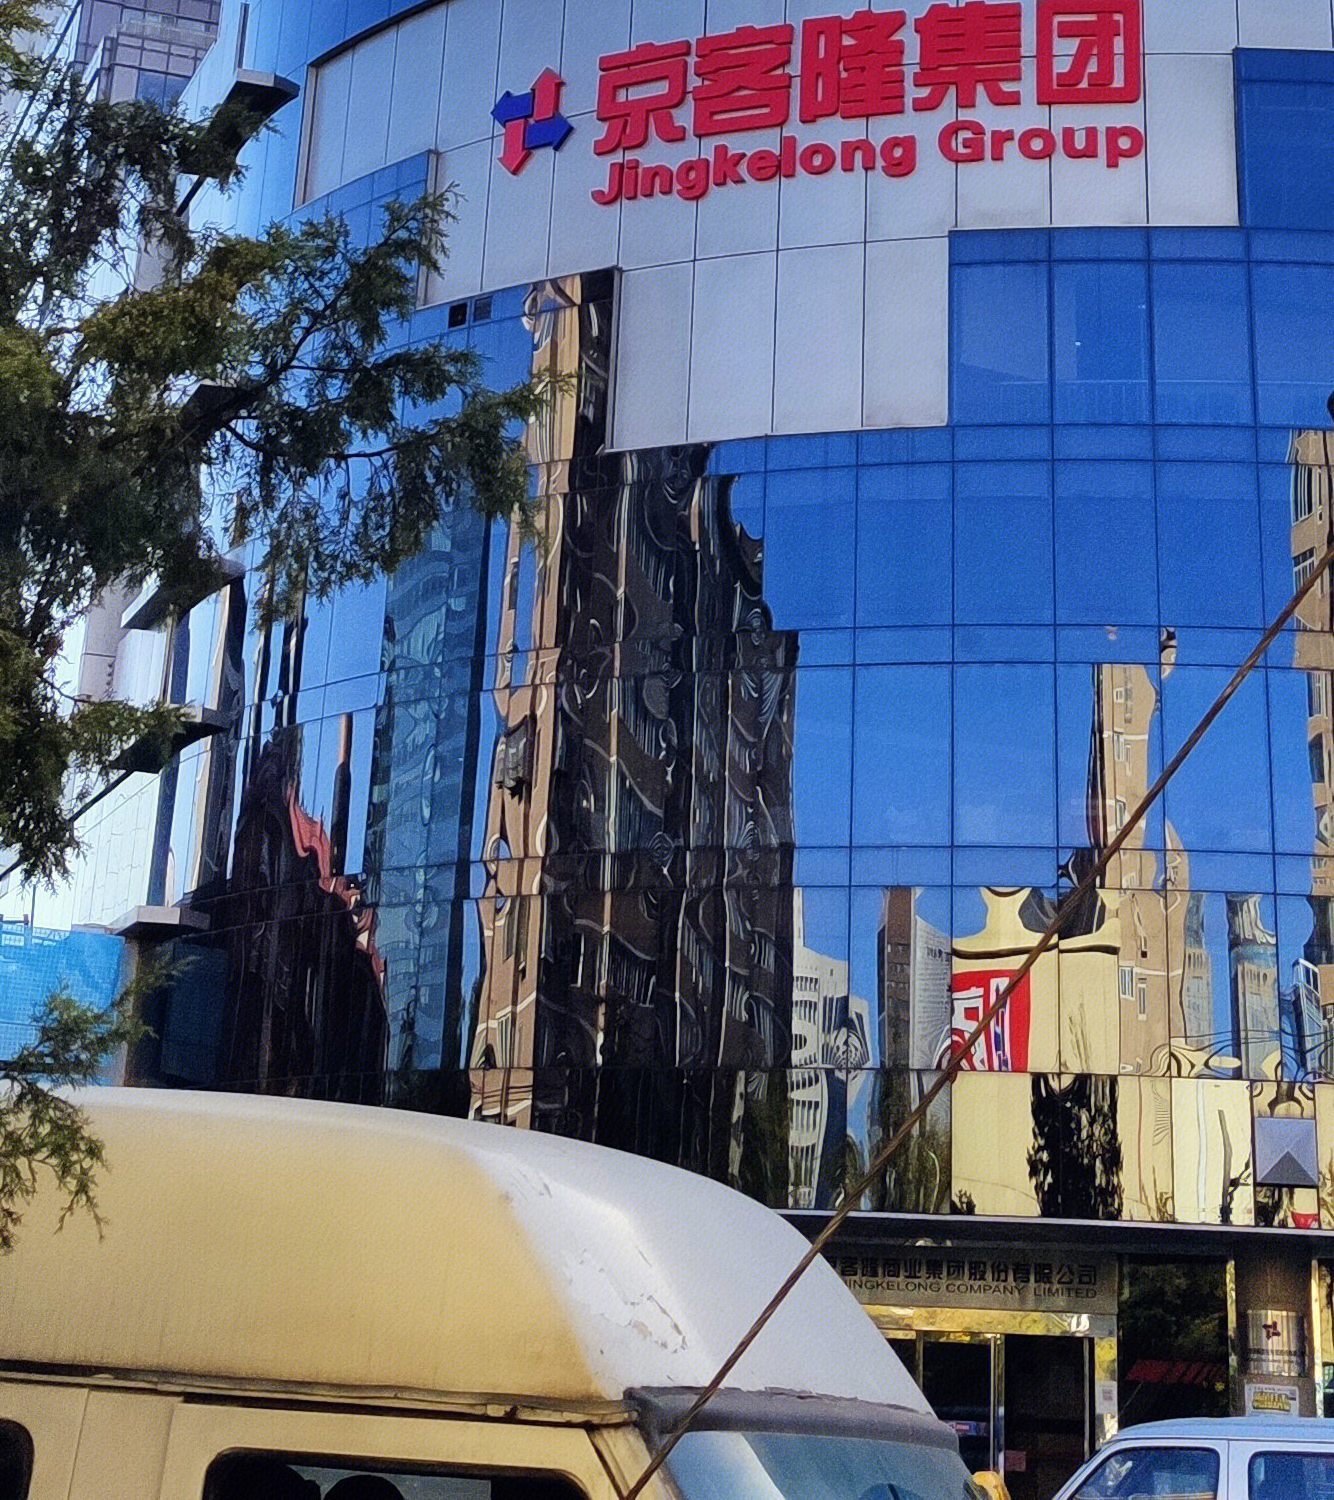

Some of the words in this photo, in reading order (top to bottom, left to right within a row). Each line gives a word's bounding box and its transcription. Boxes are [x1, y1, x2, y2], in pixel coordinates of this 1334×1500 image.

[590, 136, 917, 204] Jingkelong
[937, 119, 1145, 168] Group
[945, 1283, 1025, 1296] COMPANY
[1032, 1285, 1098, 1299] LIMITED
